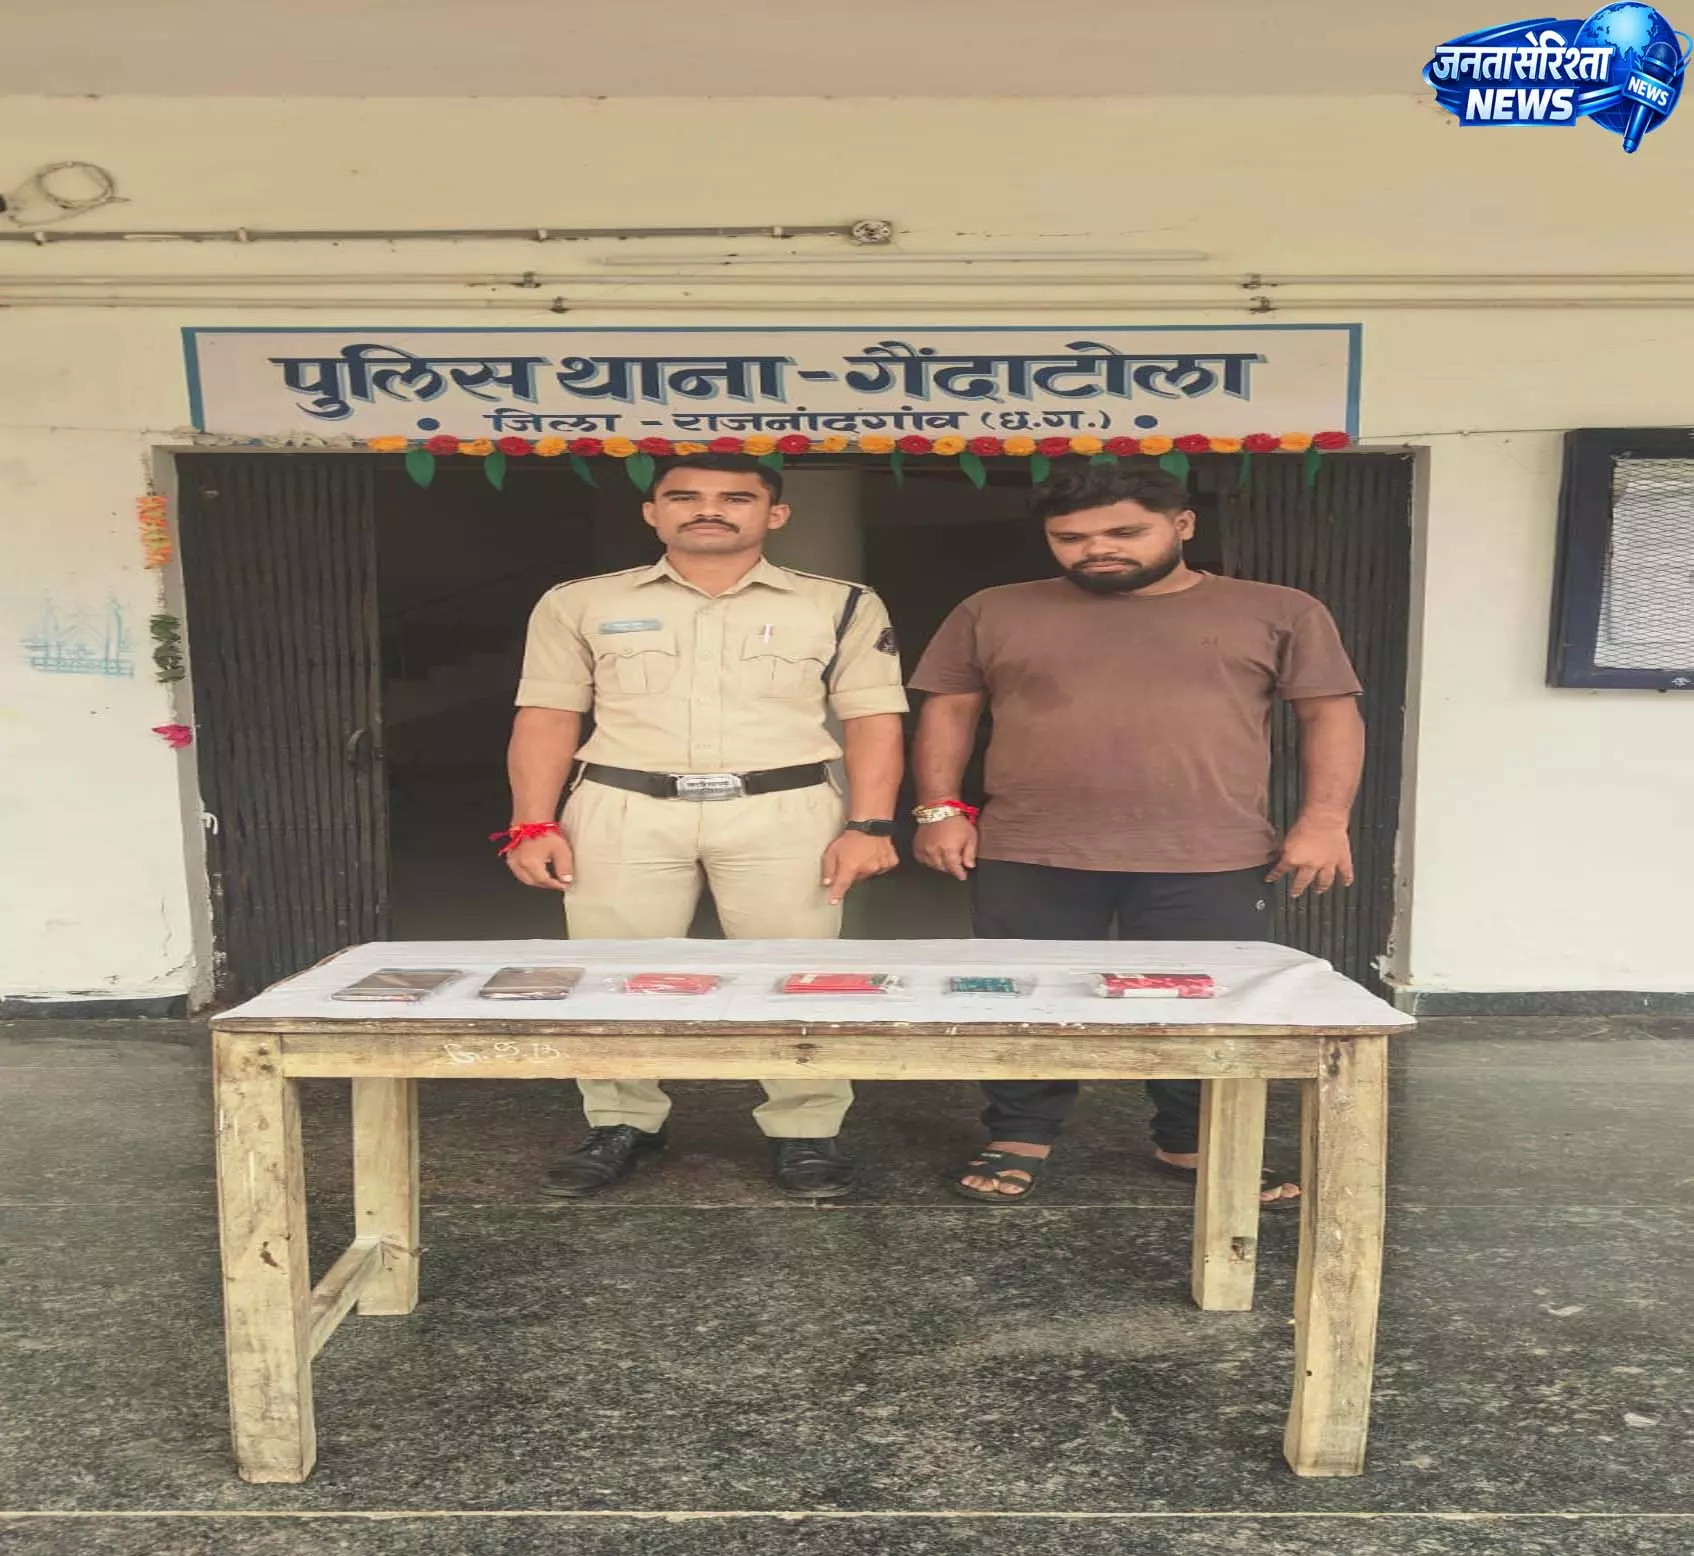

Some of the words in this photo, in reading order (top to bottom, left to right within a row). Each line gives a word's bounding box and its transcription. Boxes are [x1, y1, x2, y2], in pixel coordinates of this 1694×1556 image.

[268, 343, 551, 420] पुलिस
[482, 408, 622, 432] जिला
[672, 406, 969, 434] राजनांदगांव
